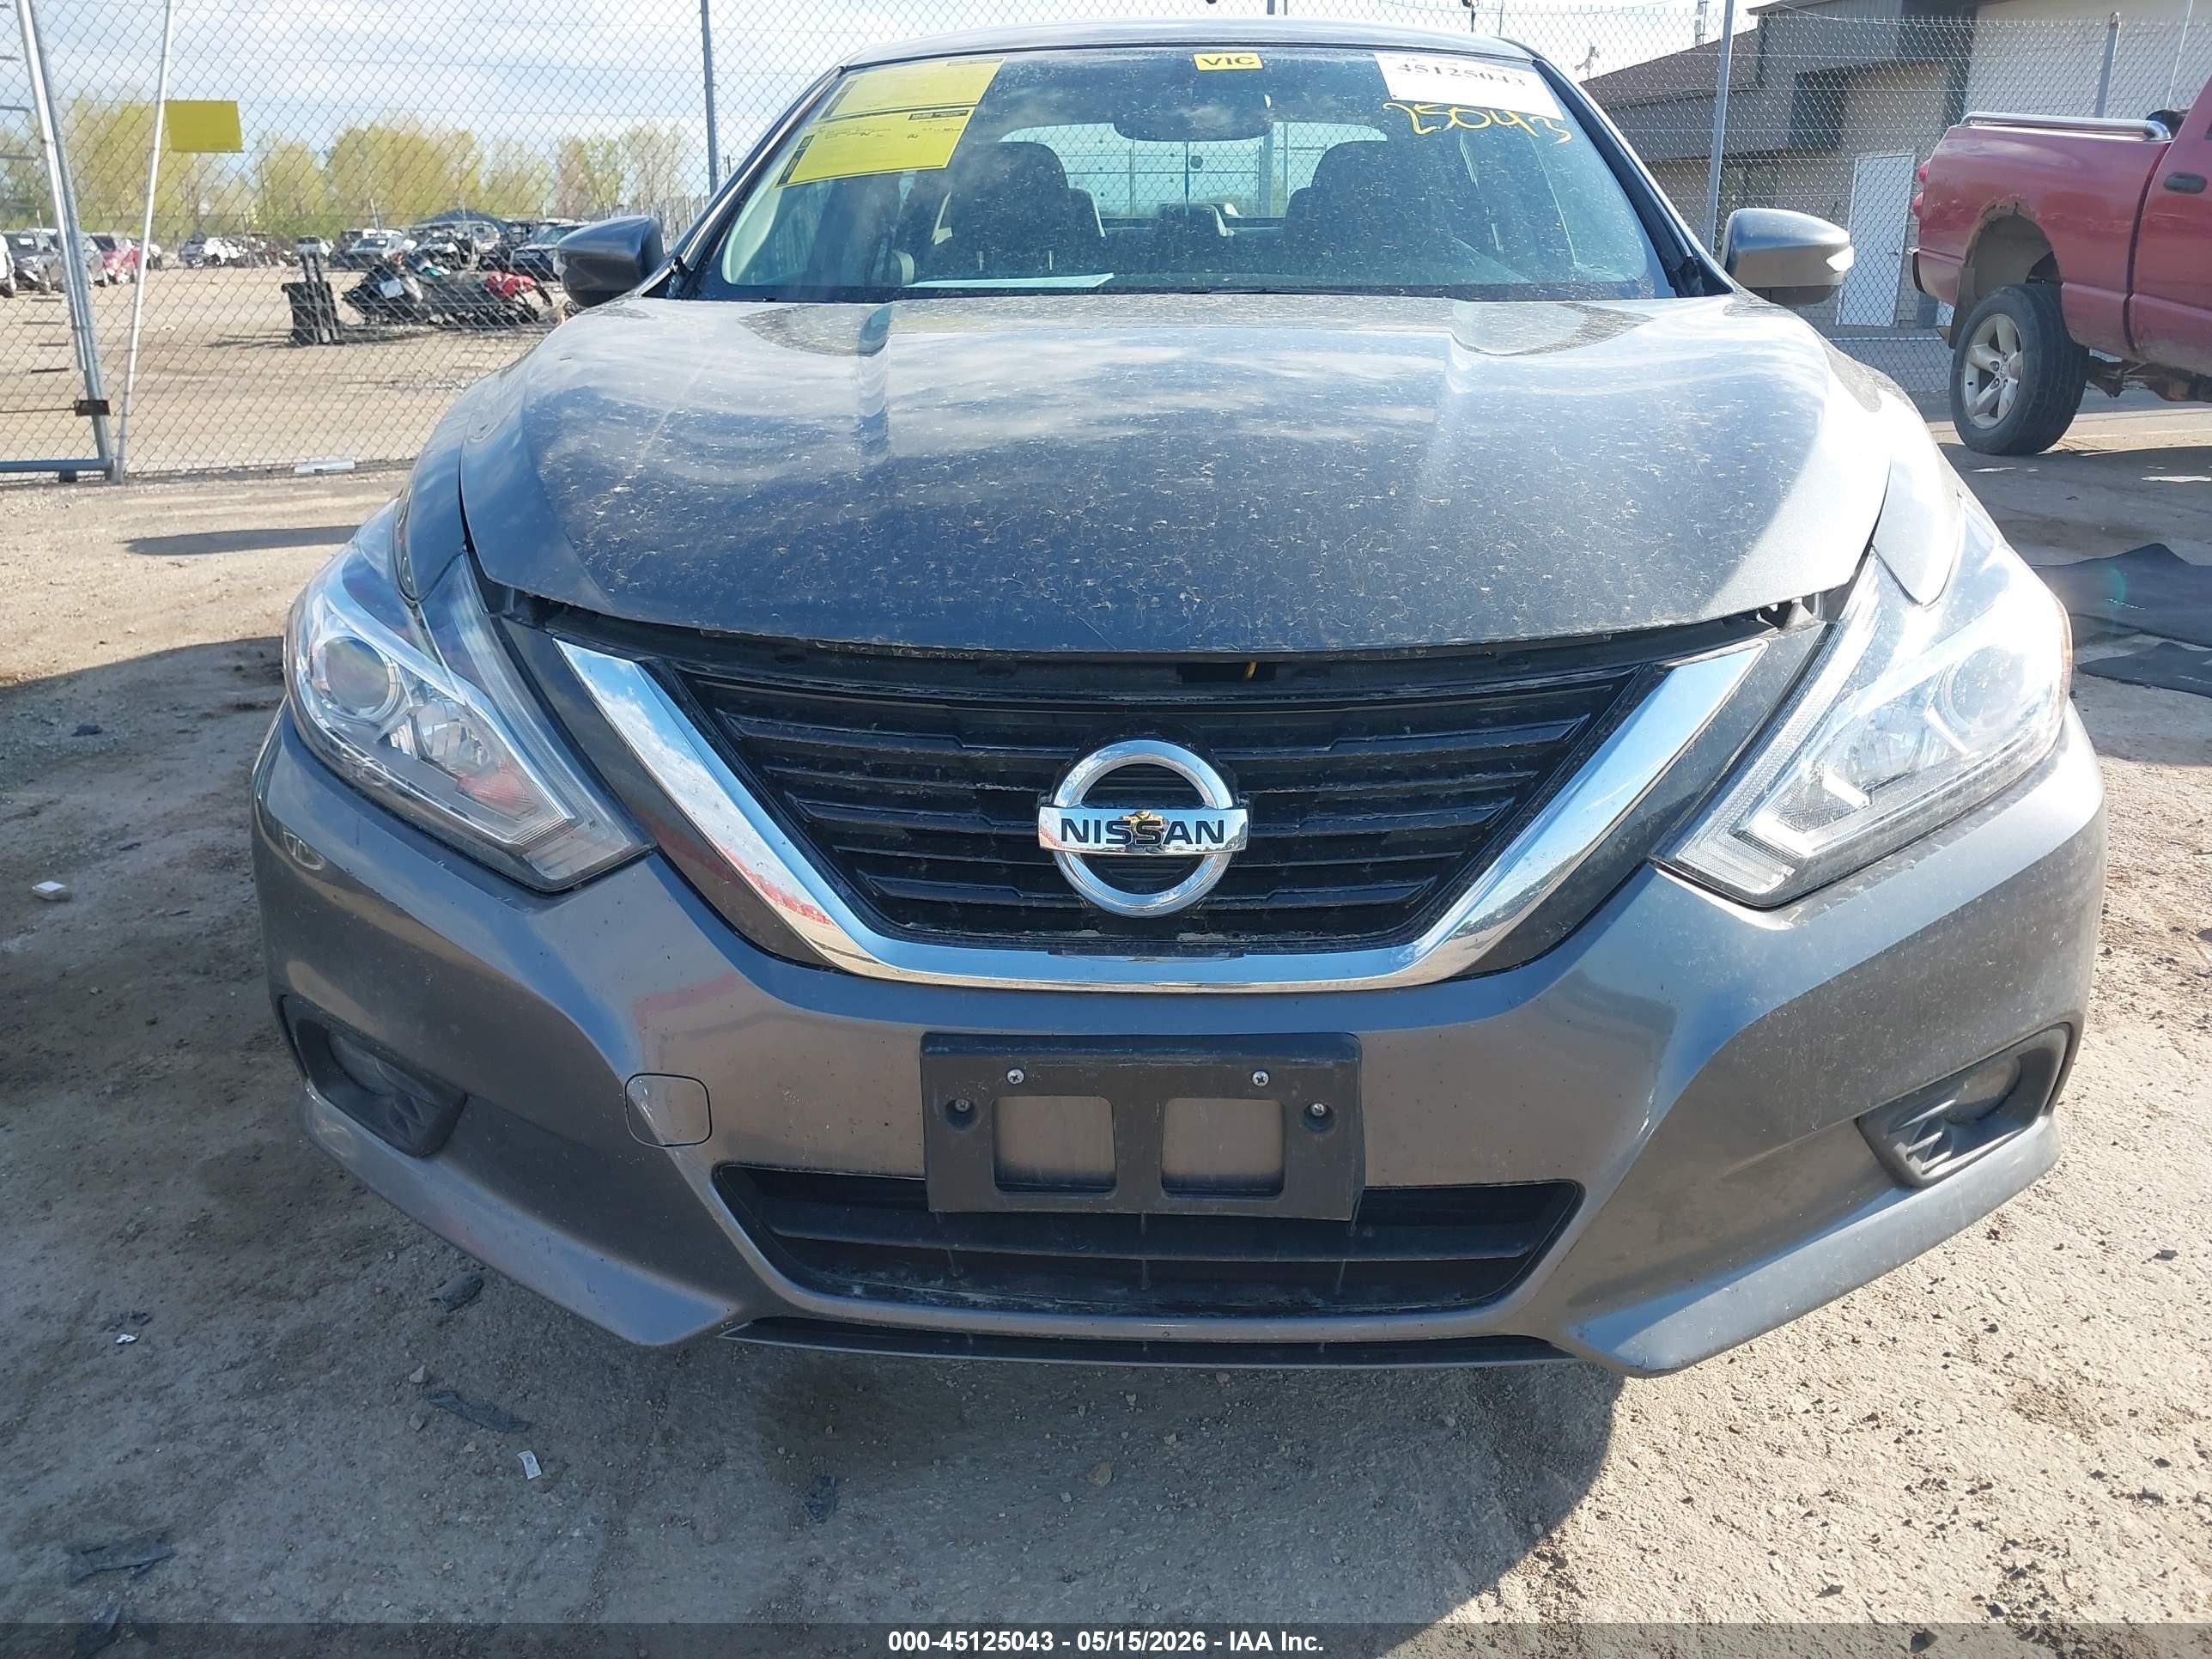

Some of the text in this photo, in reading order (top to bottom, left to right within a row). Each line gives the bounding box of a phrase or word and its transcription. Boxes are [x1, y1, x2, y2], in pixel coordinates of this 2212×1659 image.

[1201, 56, 1255, 66] VIC
[1382, 101, 1573, 145] 25043
[1060, 817, 1225, 846] NISSAN
